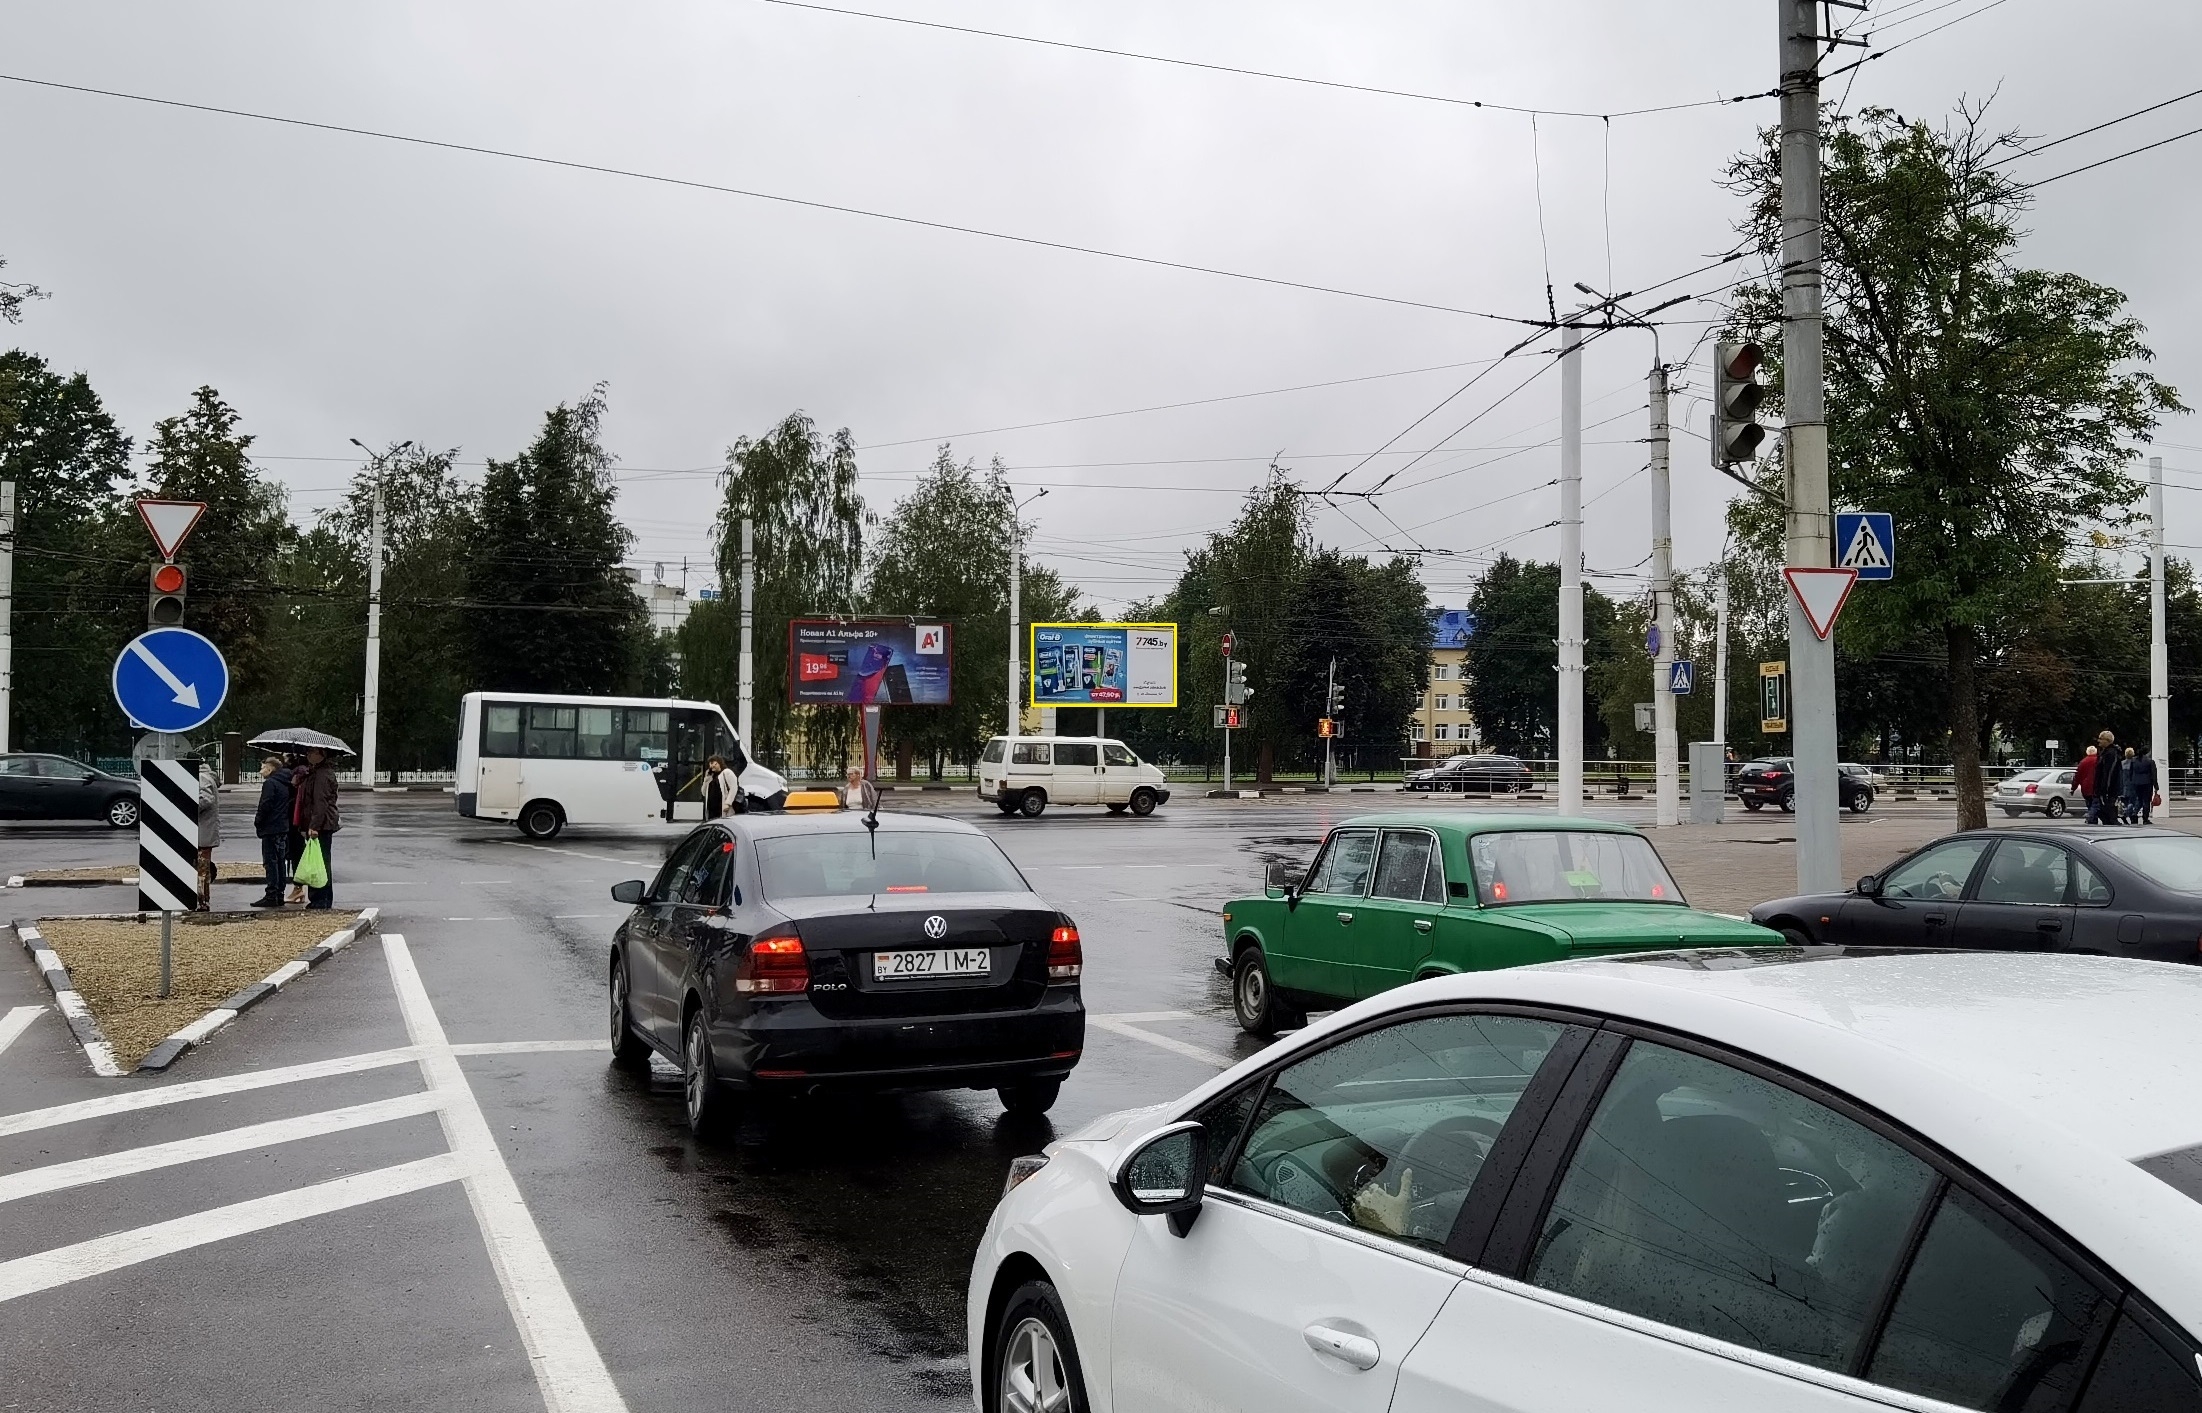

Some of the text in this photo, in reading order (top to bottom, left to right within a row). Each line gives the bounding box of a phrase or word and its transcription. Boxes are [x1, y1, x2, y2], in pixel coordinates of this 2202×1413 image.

[800, 629, 824, 637] Новая
[838, 630, 863, 639] Альфа
[921, 632, 939, 649] A1
[806, 662, 819, 674] 19
[893, 952, 936, 973] 2827
[876, 965, 888, 974] BY
[813, 982, 848, 992] POLO
